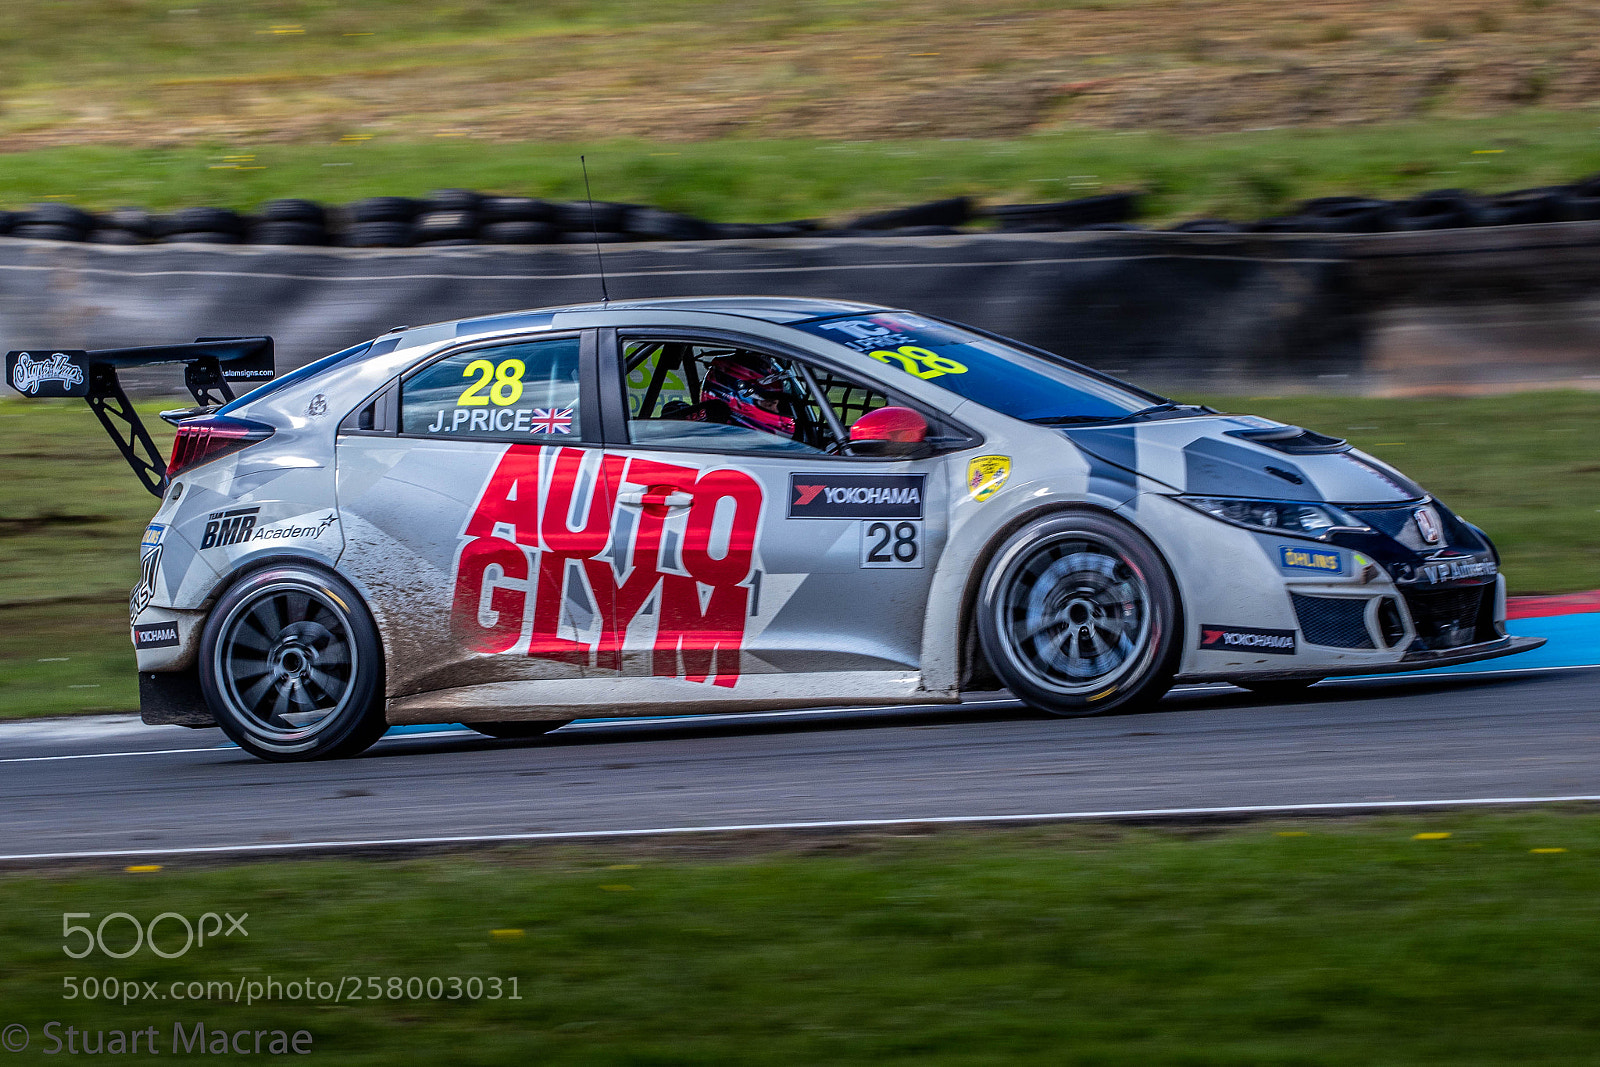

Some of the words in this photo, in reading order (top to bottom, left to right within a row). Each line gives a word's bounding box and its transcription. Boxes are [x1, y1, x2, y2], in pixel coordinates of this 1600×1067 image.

[868, 345, 968, 380] 28
[457, 358, 526, 406] 28
[428, 409, 532, 432] J.PRICE
[824, 487, 921, 504] YOKOHAMA
[200, 515, 258, 550] BMR
[252, 524, 327, 542] Academy
[462, 443, 764, 587] AUTO
[867, 521, 918, 563] 28
[450, 536, 750, 688] GLYM
[139, 628, 178, 643] YOKOHAMA
[1222, 632, 1295, 648] YOKOHAMA
